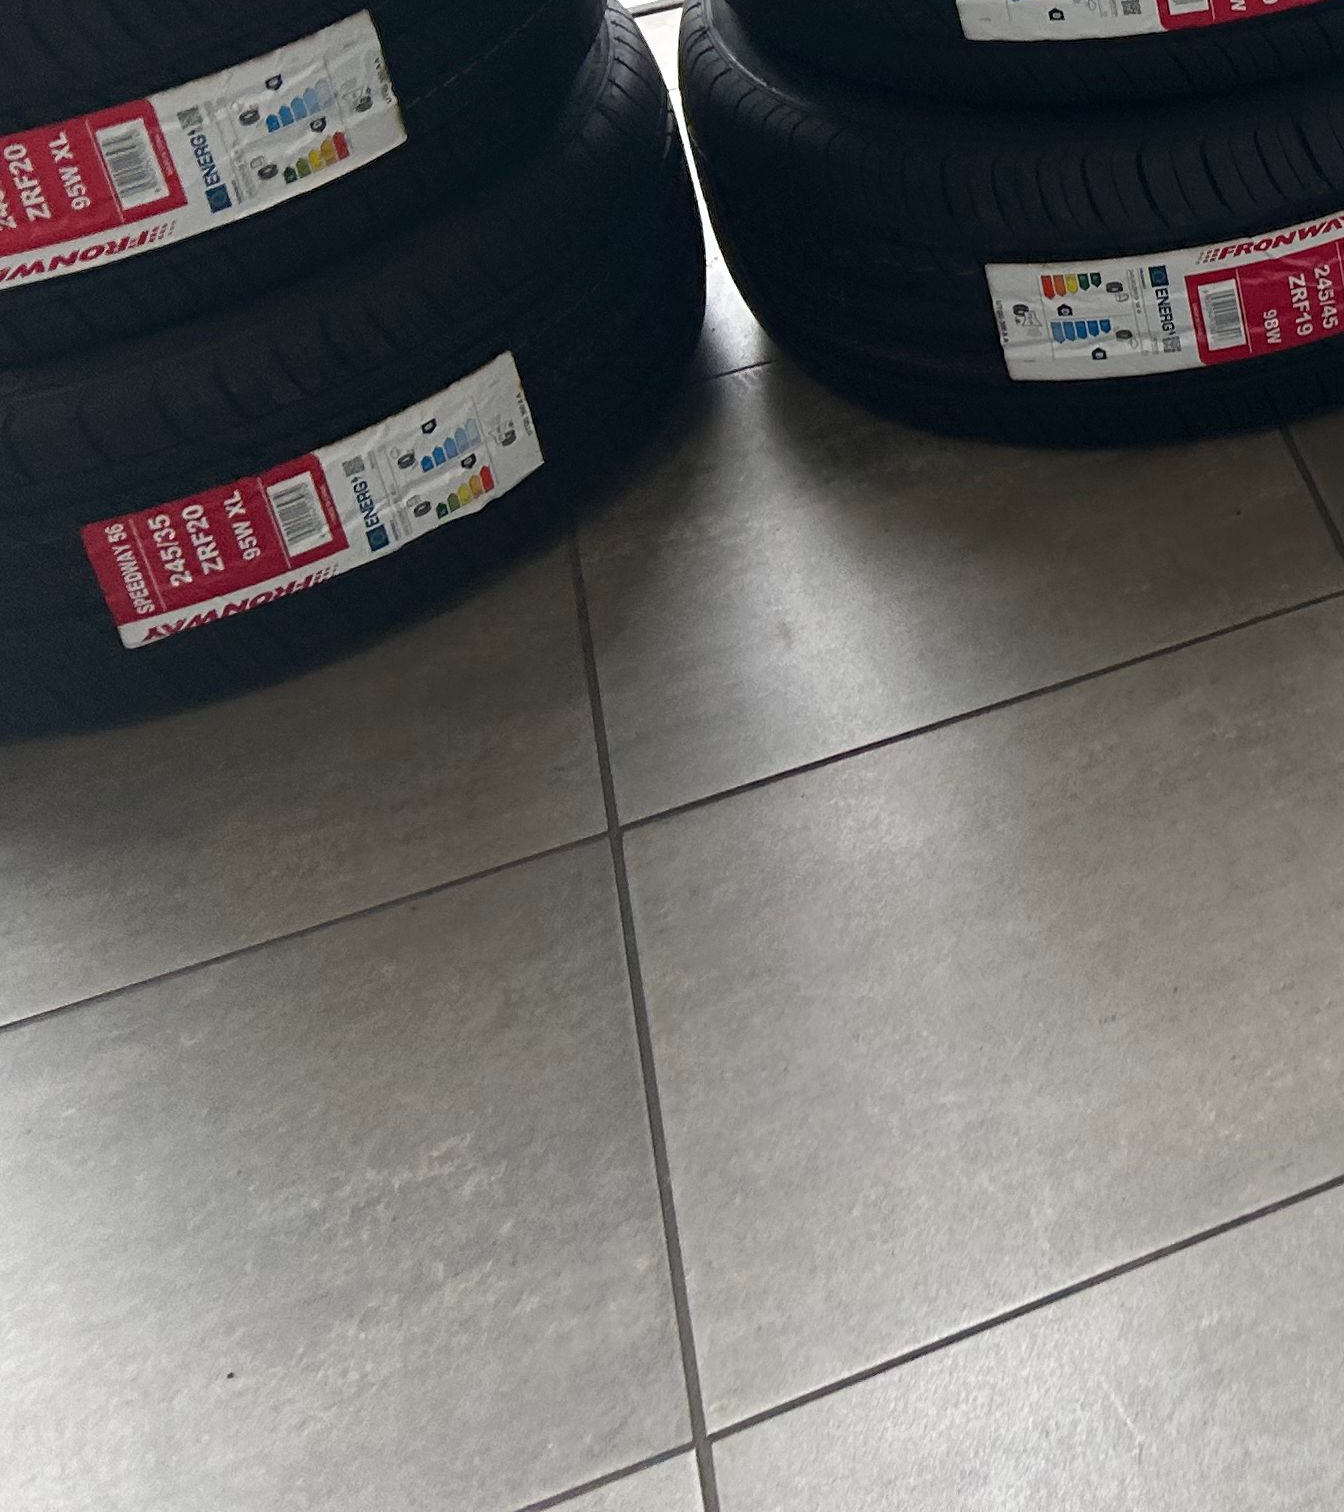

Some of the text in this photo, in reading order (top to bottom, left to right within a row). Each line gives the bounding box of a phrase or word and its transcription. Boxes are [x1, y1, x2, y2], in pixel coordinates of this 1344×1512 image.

[3, 143, 52, 222] ZRF20
[48, 131, 91, 211] 95W XL
[1262, 308, 1282, 344] 98W
[1288, 273, 1314, 336] ZRF19
[1313, 264, 1339, 329] 245/45
[147, 513, 193, 587] 245/35
[181, 503, 225, 576] ZRF20
[223, 488, 261, 561] 95W XL
[104, 522, 155, 615] SPEEDWAY 56
